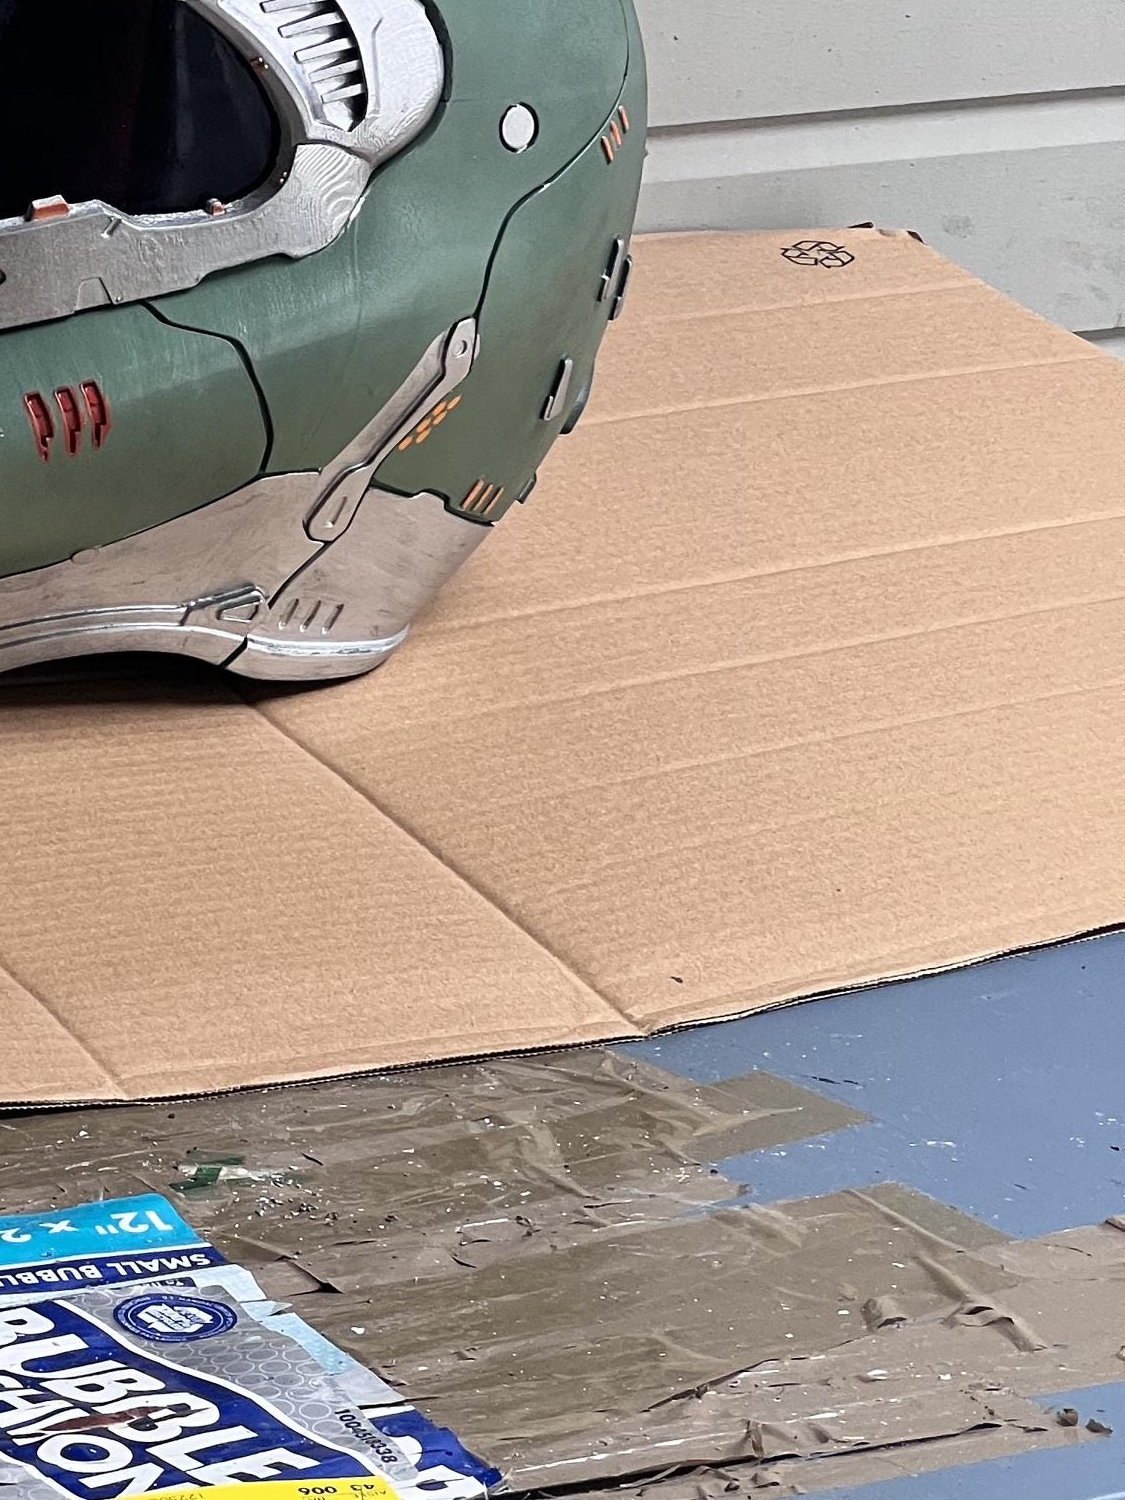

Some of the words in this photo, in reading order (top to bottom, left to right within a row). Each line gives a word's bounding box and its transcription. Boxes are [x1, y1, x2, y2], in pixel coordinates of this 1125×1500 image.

[94, 1209, 174, 1236] 12"
[105, 1253, 211, 1277] SMALL
[297, 1486, 338, 1496] 006
